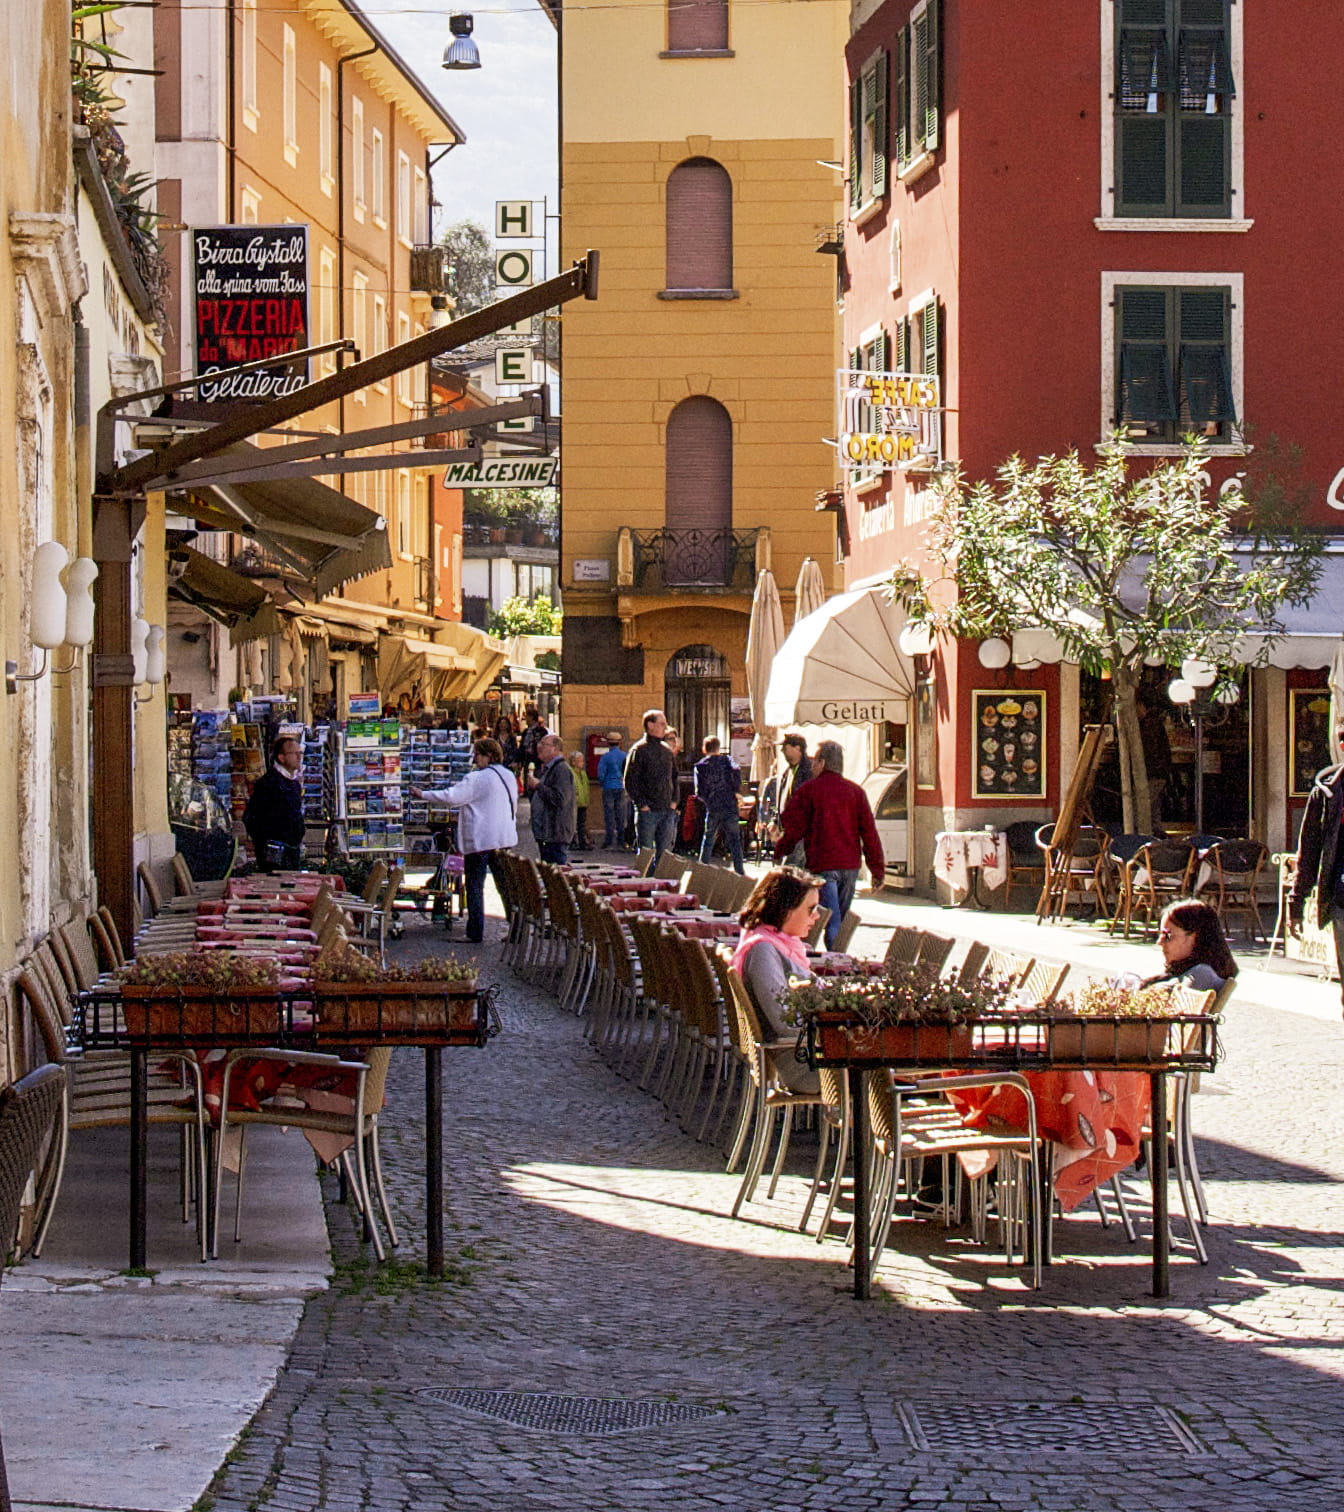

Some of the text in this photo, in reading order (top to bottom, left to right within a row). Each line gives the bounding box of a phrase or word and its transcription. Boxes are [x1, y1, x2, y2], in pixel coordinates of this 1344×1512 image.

[196, 236, 244, 265] Birra
[197, 268, 221, 294] alla
[280, 270, 306, 294] Fass
[197, 299, 305, 335] PIZZERIA
[498, 205, 530, 429] HOEL
[200, 366, 305, 403] Gelateria
[446, 461, 554, 483] MALCESINE
[822, 701, 886, 721] Gelati
